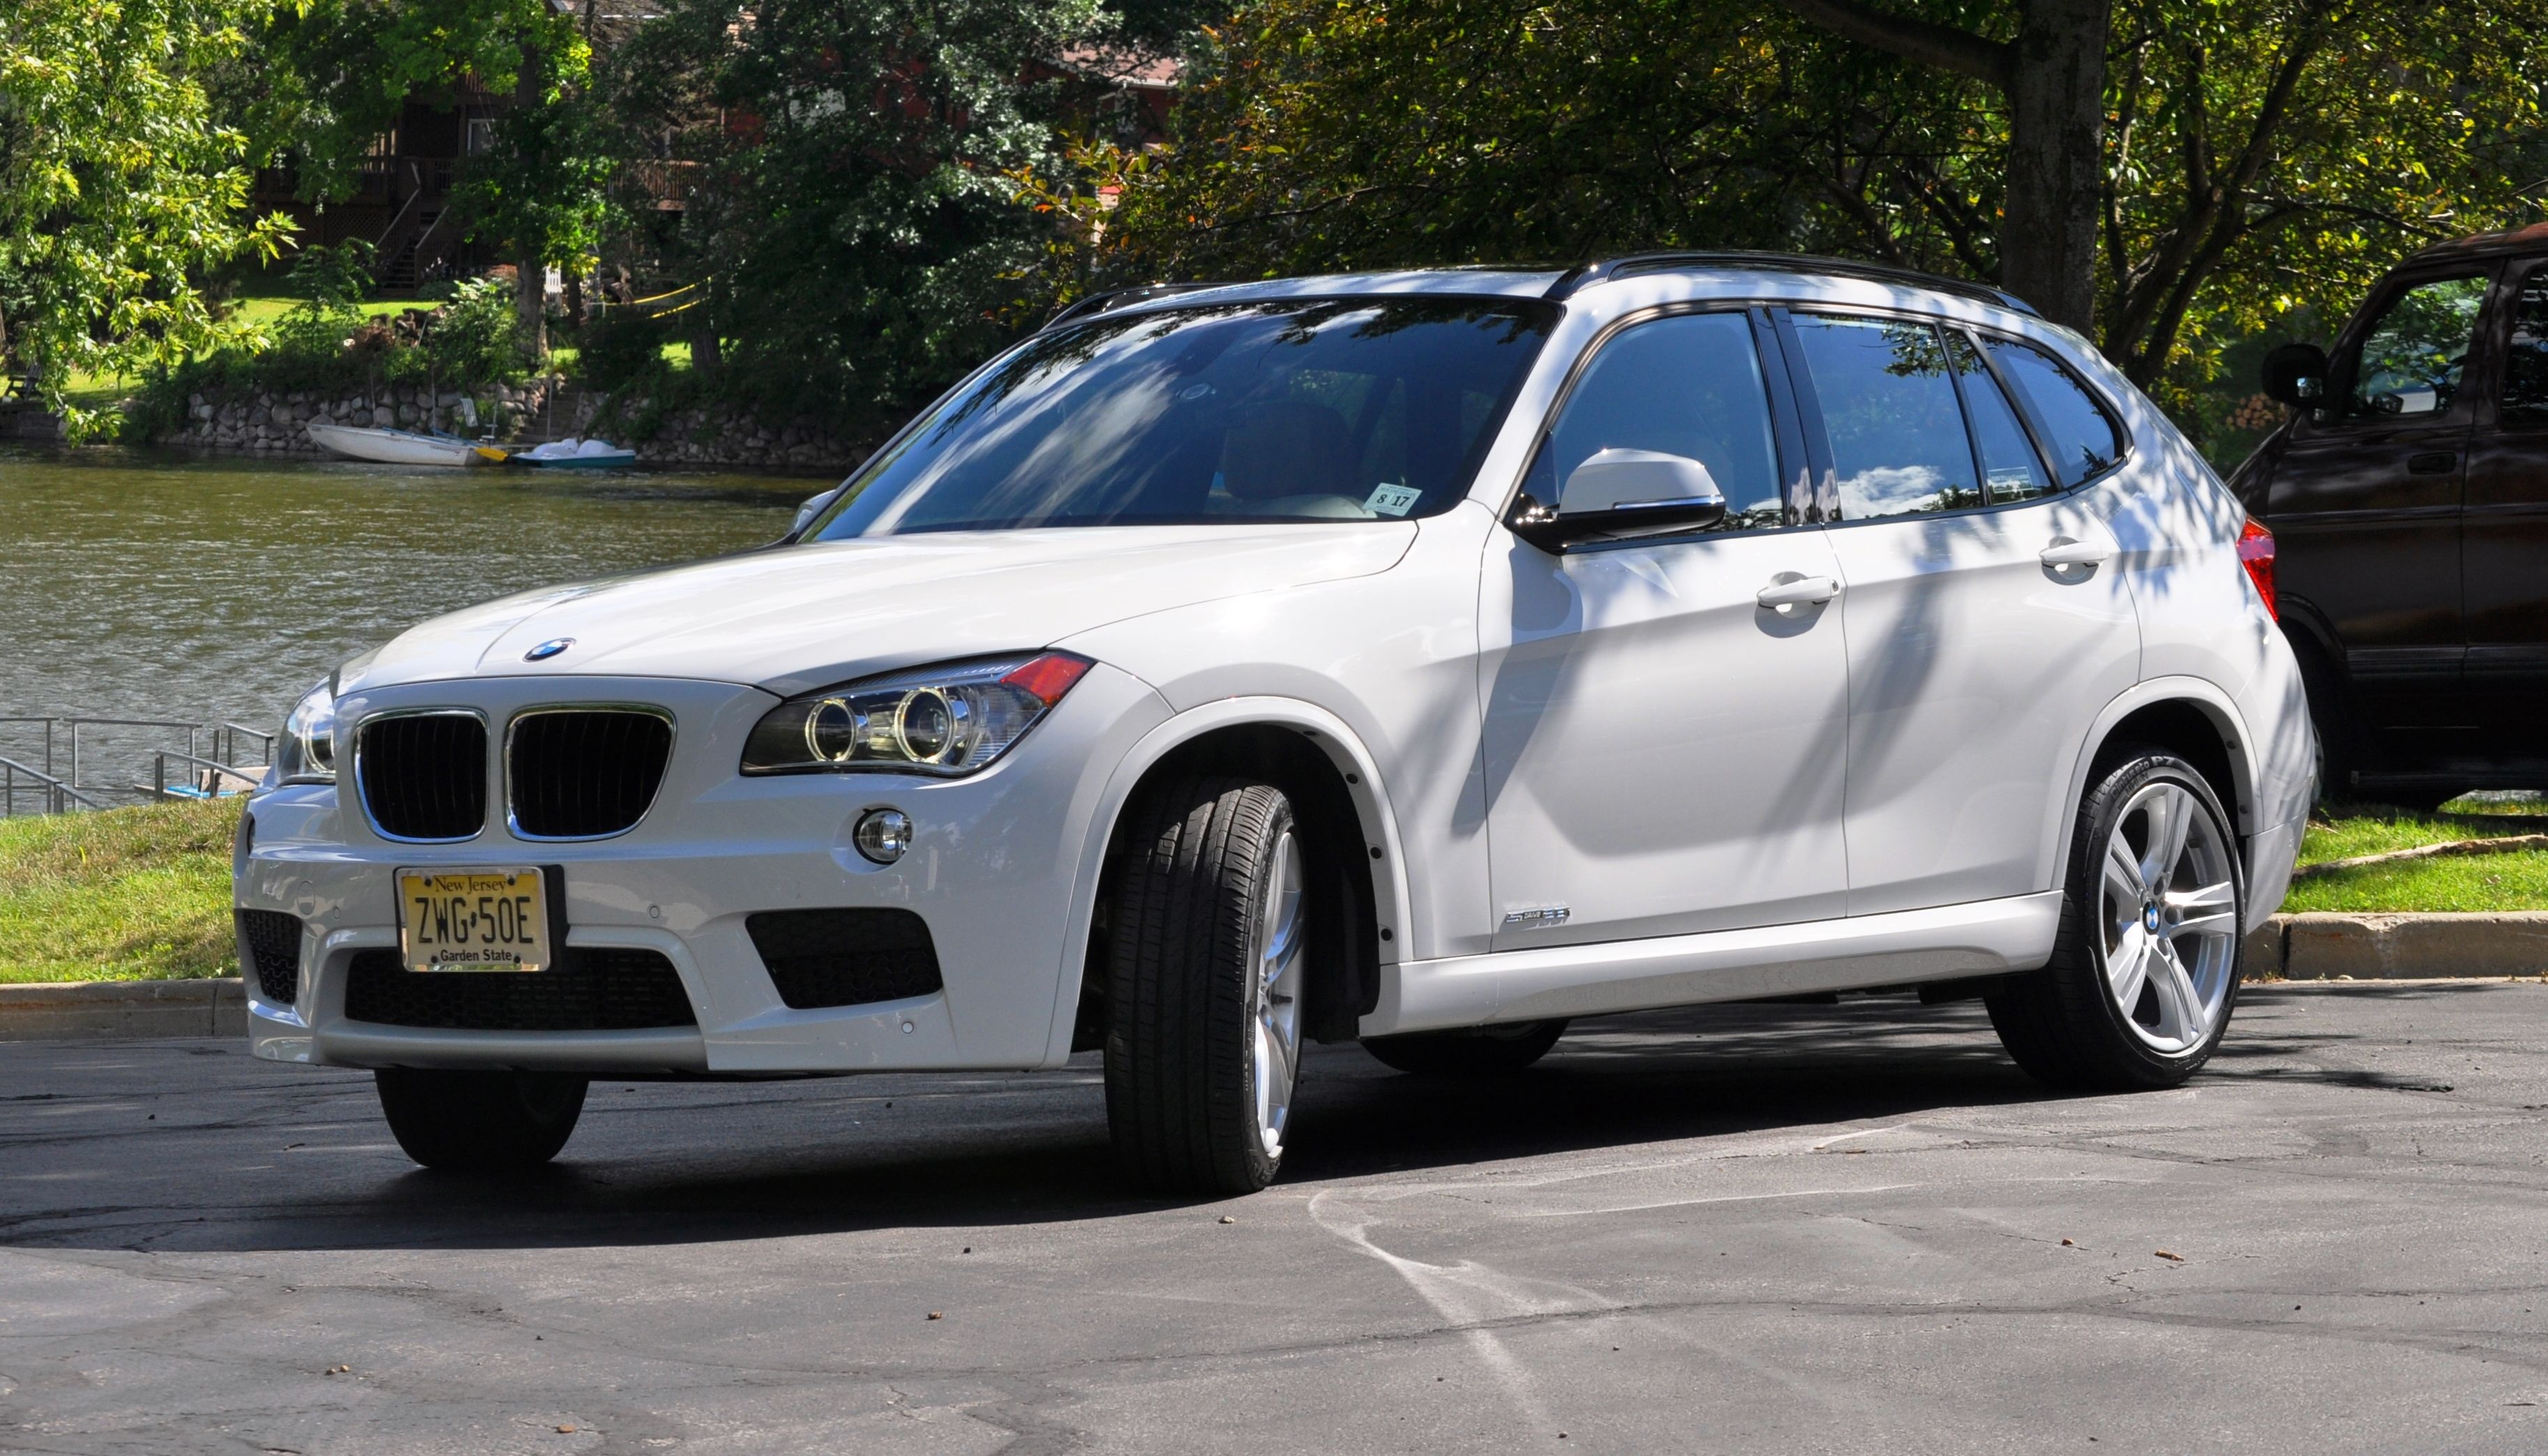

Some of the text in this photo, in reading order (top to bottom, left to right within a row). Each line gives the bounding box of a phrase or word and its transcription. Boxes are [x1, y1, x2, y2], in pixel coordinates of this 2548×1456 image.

[1377, 494, 1411, 507] 8 17
[2151, 756, 2175, 766] P7
[435, 876, 507, 894] New Jersey
[440, 949, 512, 961] Garden State
